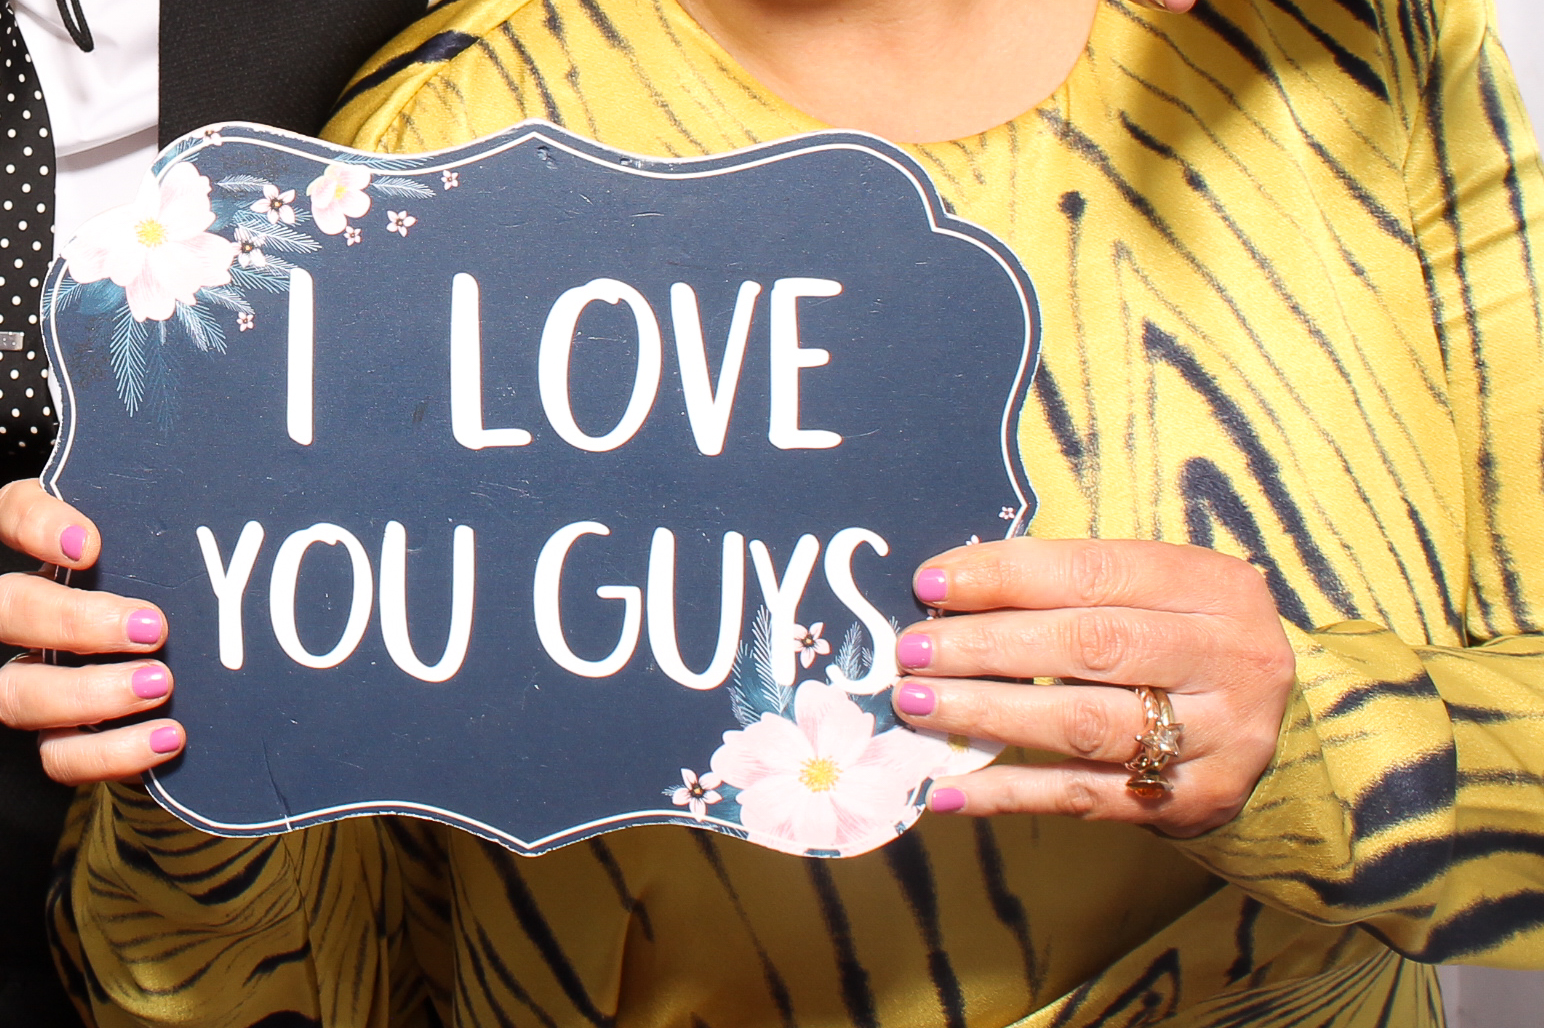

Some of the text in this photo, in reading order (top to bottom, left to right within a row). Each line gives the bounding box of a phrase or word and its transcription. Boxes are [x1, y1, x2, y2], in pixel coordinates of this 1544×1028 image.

[286, 267, 843, 456] I LOVE
[196, 520, 898, 695] YOU GUYS
